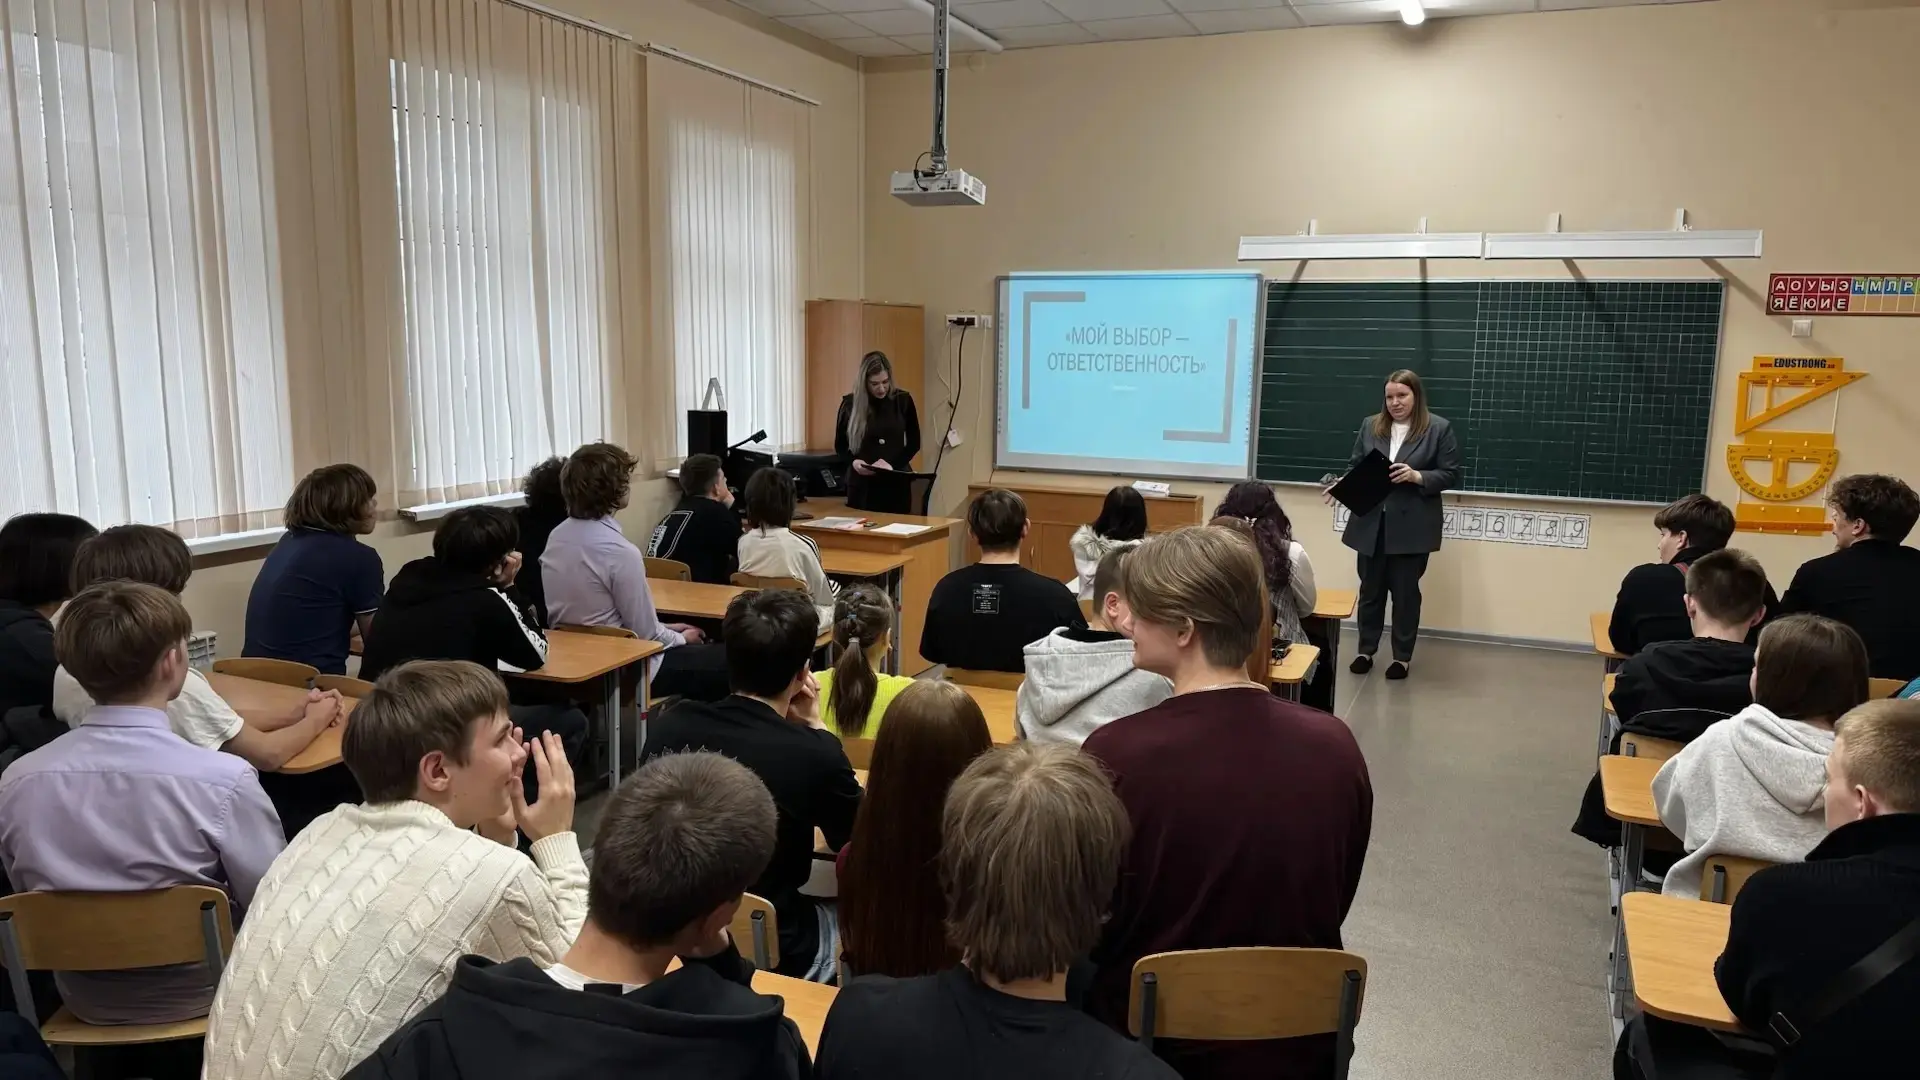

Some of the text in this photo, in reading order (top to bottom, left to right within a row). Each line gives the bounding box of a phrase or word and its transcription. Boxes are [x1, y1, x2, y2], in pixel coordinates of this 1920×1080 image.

[1065, 322, 1108, 345] «МОЙ
[1113, 327, 1172, 346] ВЫБОР
[1047, 352, 1207, 375] ОТВЕТСТВЕННОСТЬ»
[1774, 358, 1827, 369] EDUSTRONG
[1469, 512, 1482, 531] 5
[1493, 515, 1505, 533] 6
[1521, 517, 1534, 536] 7
[1545, 520, 1558, 537] 8
[1570, 520, 1585, 538] 9
